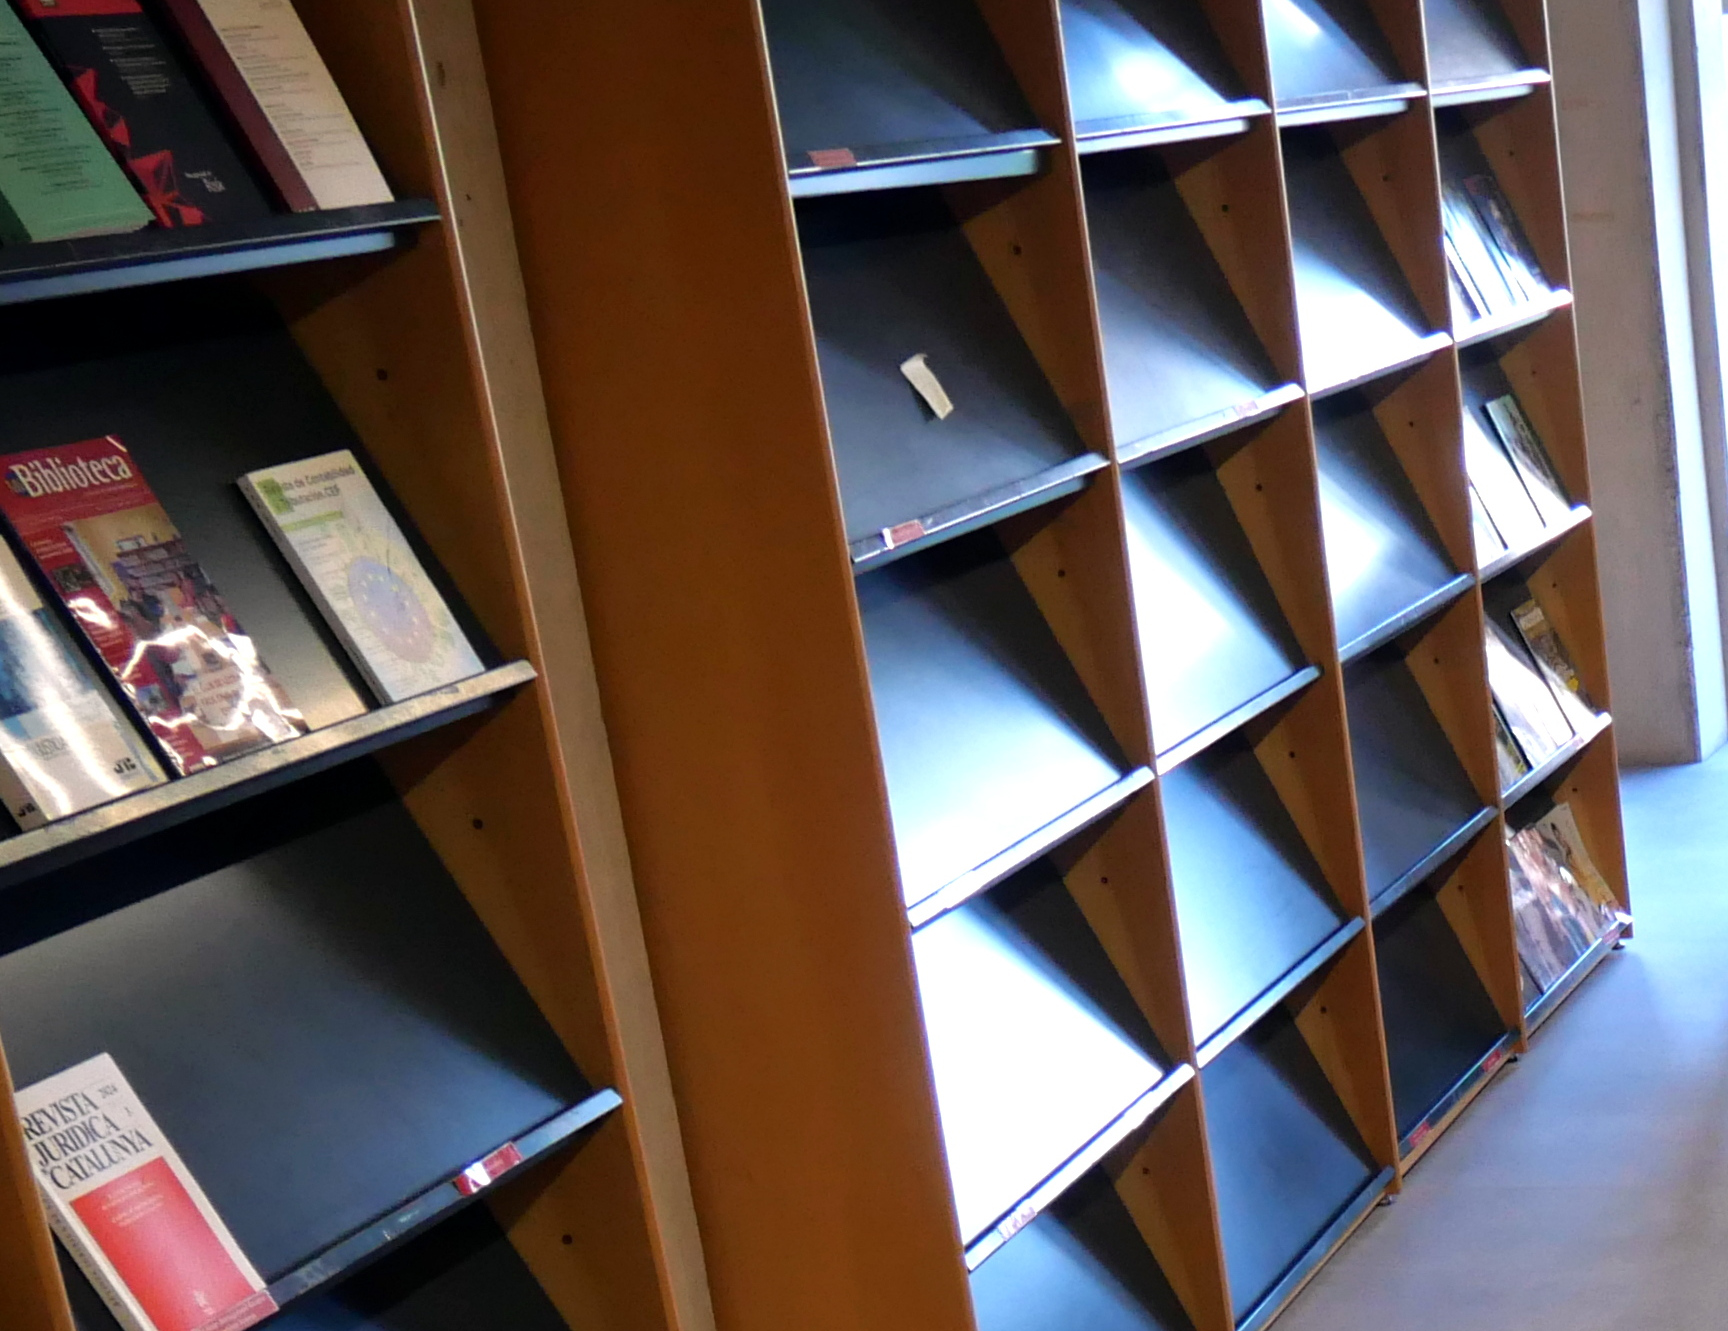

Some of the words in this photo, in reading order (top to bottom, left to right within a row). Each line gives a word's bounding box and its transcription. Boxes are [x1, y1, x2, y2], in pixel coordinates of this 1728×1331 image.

[9, 455, 133, 498] Biblioteca
[20, 1092, 99, 1141] REVISTA
[50, 1128, 153, 1190] CATALUNYA
